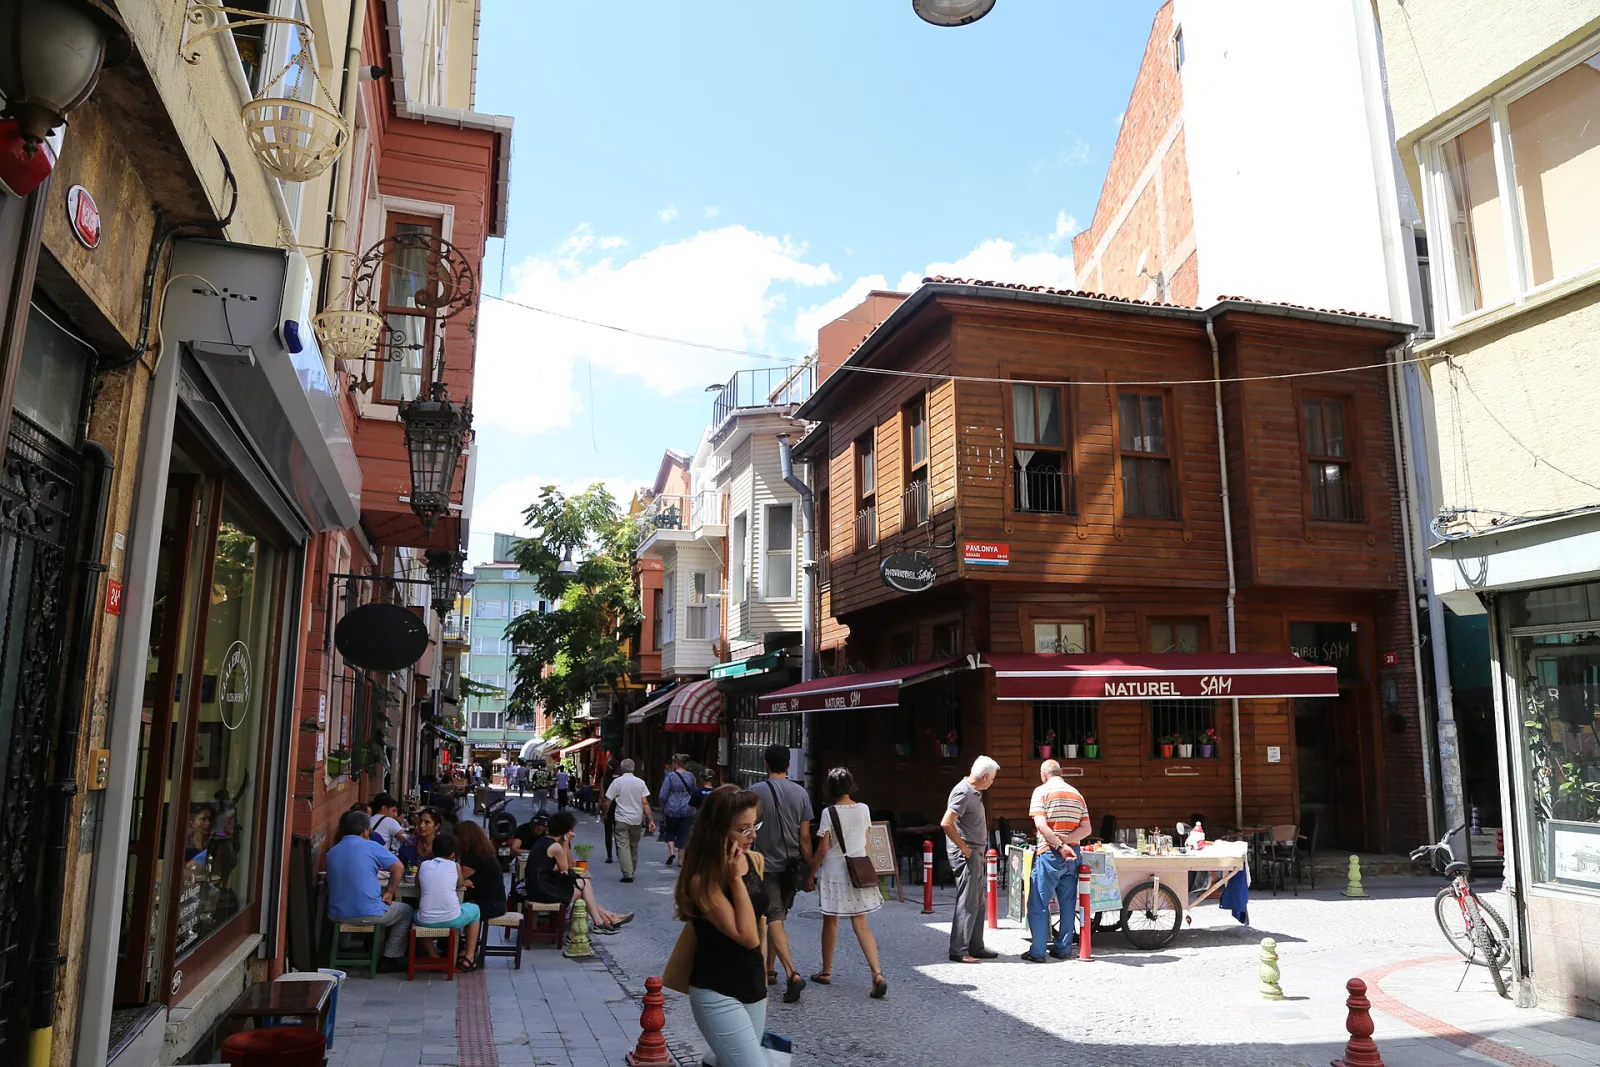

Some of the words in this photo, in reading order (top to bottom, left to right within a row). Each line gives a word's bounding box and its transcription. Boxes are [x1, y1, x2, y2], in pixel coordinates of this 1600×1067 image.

[965, 544, 999, 553] PAVLONYA
[1322, 641, 1350, 661] SAM
[1387, 655, 1394, 663] 28
[1104, 682, 1181, 696] NATUREL
[1200, 676, 1232, 695] SAM
[771, 702, 788, 712] NATUREL
[790, 697, 800, 710] SAM
[824, 697, 847, 709] NATUREL
[849, 691, 861, 708] SAM
